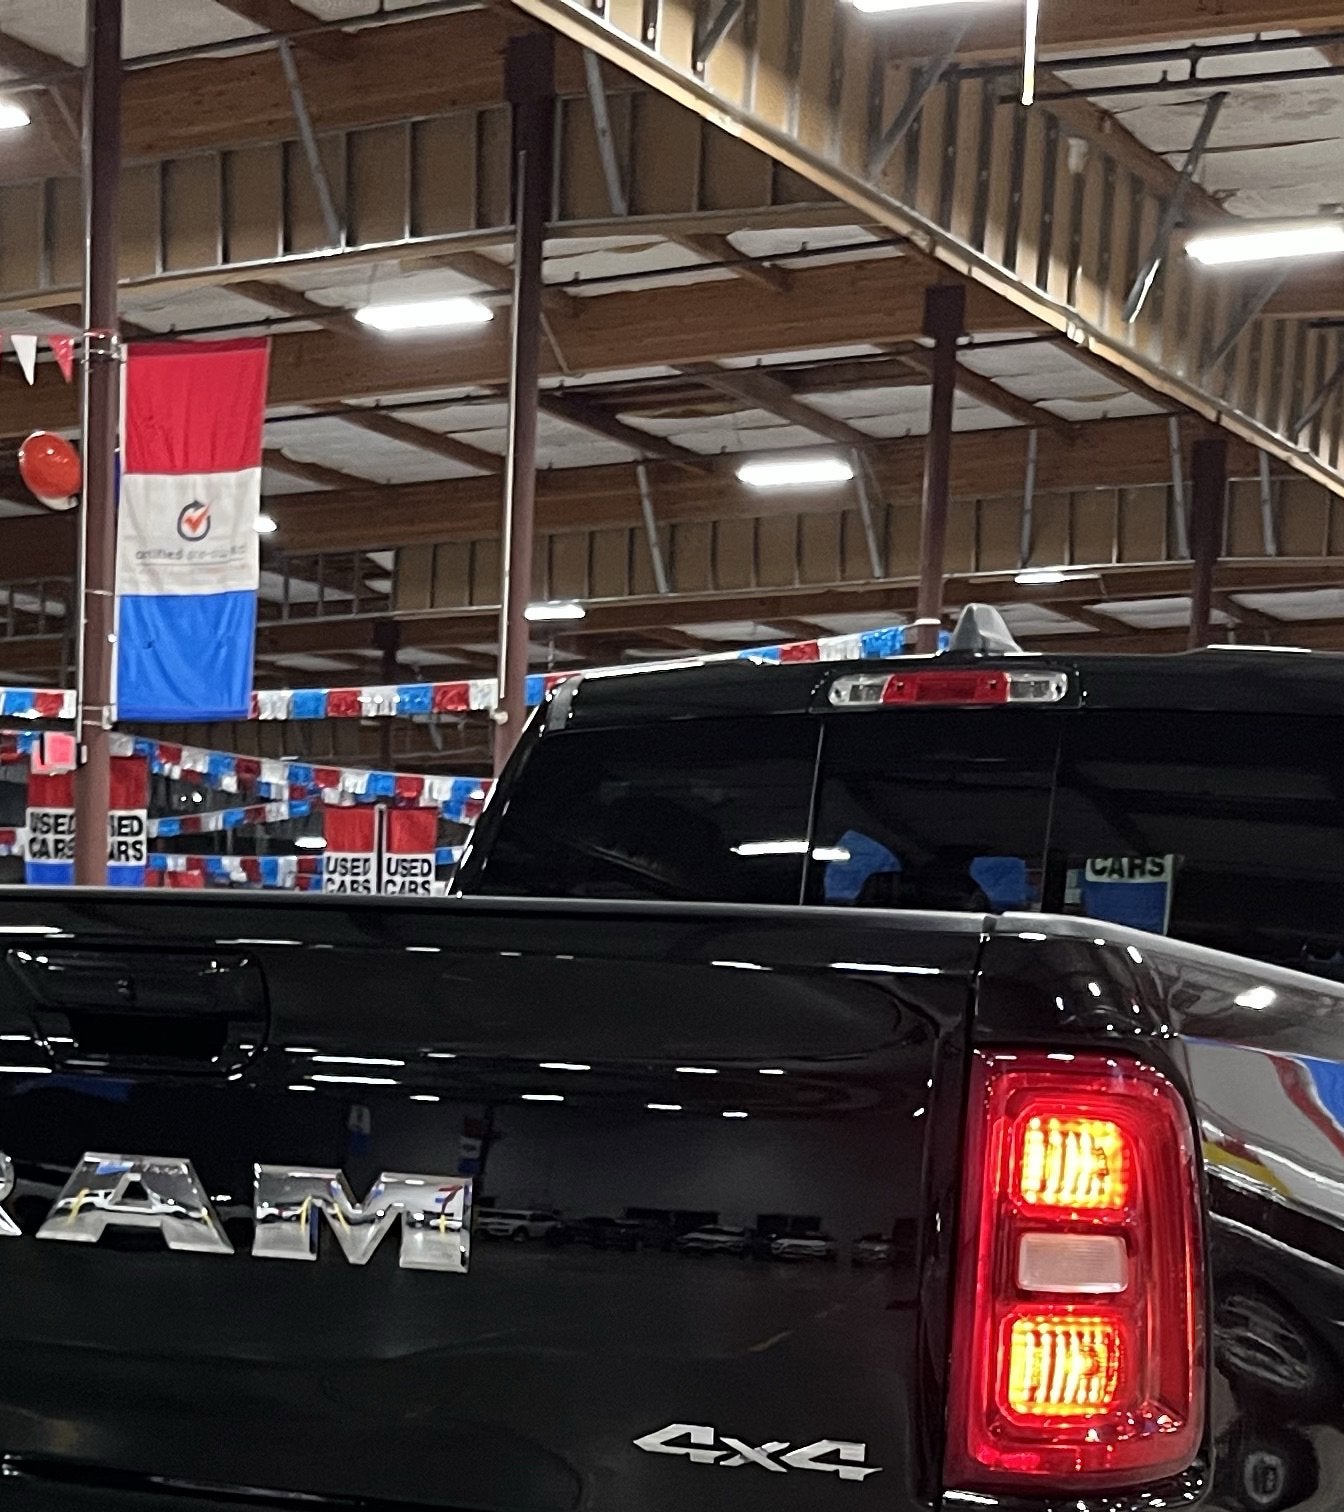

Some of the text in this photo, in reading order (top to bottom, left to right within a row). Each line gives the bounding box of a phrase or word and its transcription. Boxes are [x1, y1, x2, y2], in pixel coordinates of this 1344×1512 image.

[326, 856, 371, 876] USED
[387, 857, 432, 877] USED
[1091, 857, 1165, 878] CARS
[633, 1423, 883, 1481] 4x4
